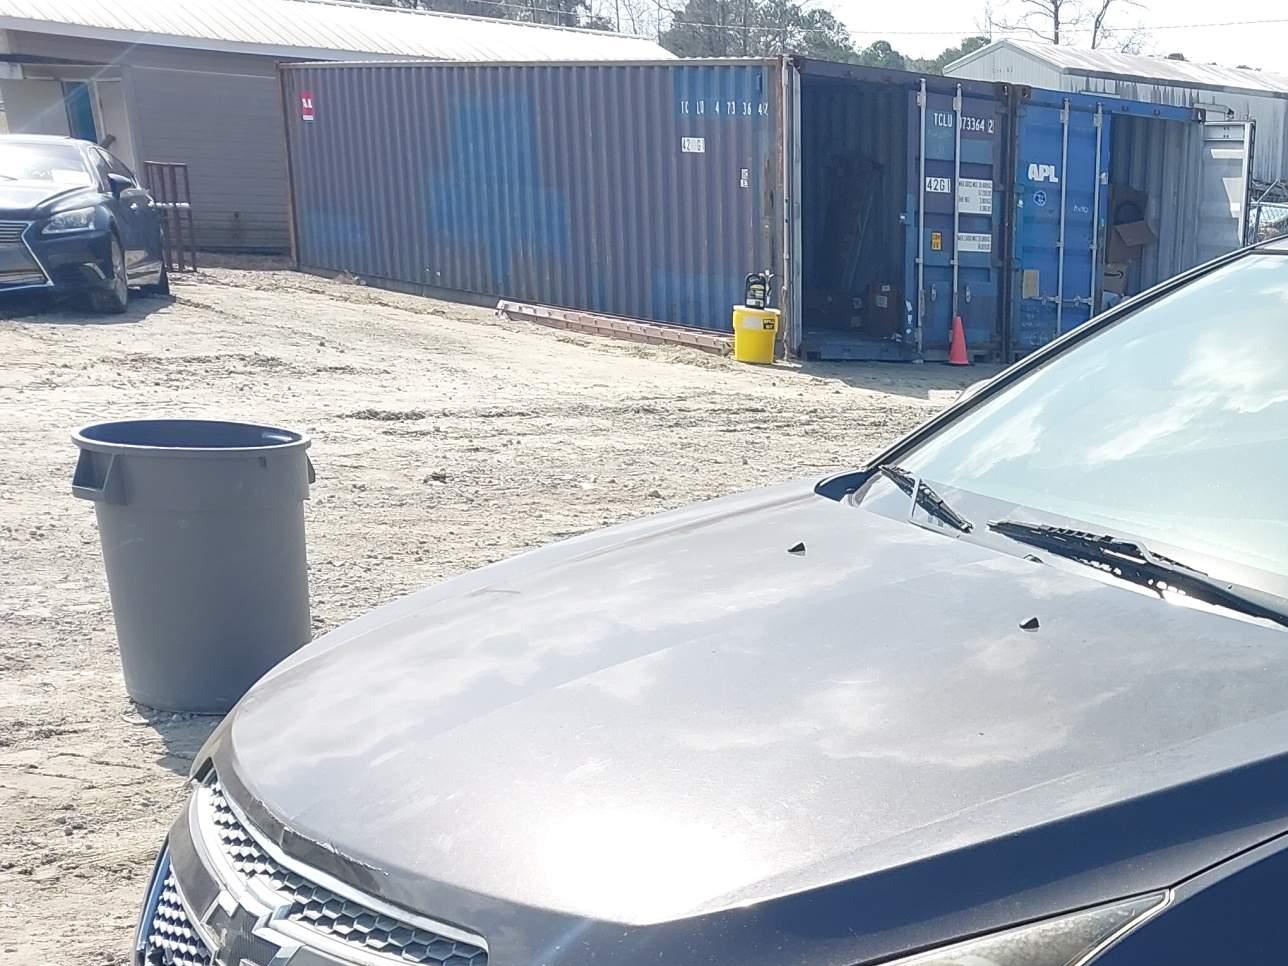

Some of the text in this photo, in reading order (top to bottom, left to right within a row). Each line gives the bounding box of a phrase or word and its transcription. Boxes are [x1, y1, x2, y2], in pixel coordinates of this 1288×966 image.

[934, 112, 953, 128] TCLU
[960, 116, 985, 131] 73364
[1027, 163, 1059, 183] APL
[926, 178, 950, 192] 42G1
